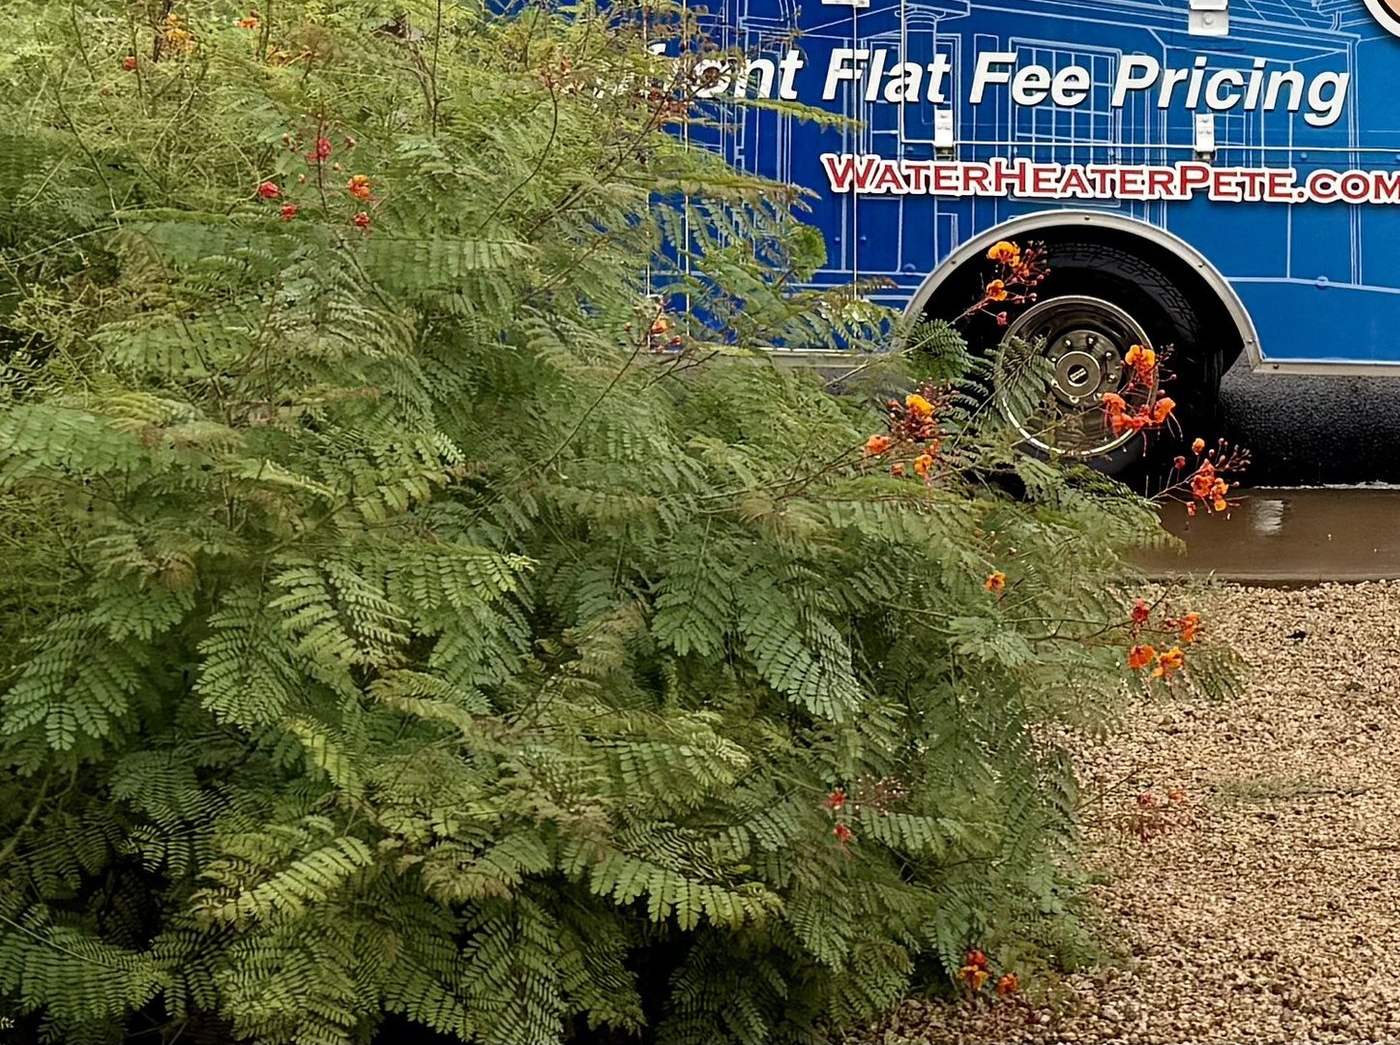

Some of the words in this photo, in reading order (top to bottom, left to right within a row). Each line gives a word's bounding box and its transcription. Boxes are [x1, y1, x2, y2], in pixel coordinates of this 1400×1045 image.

[821, 48, 952, 105] Flat
[969, 51, 1091, 107] Fee
[1111, 53, 1351, 127] Pricing
